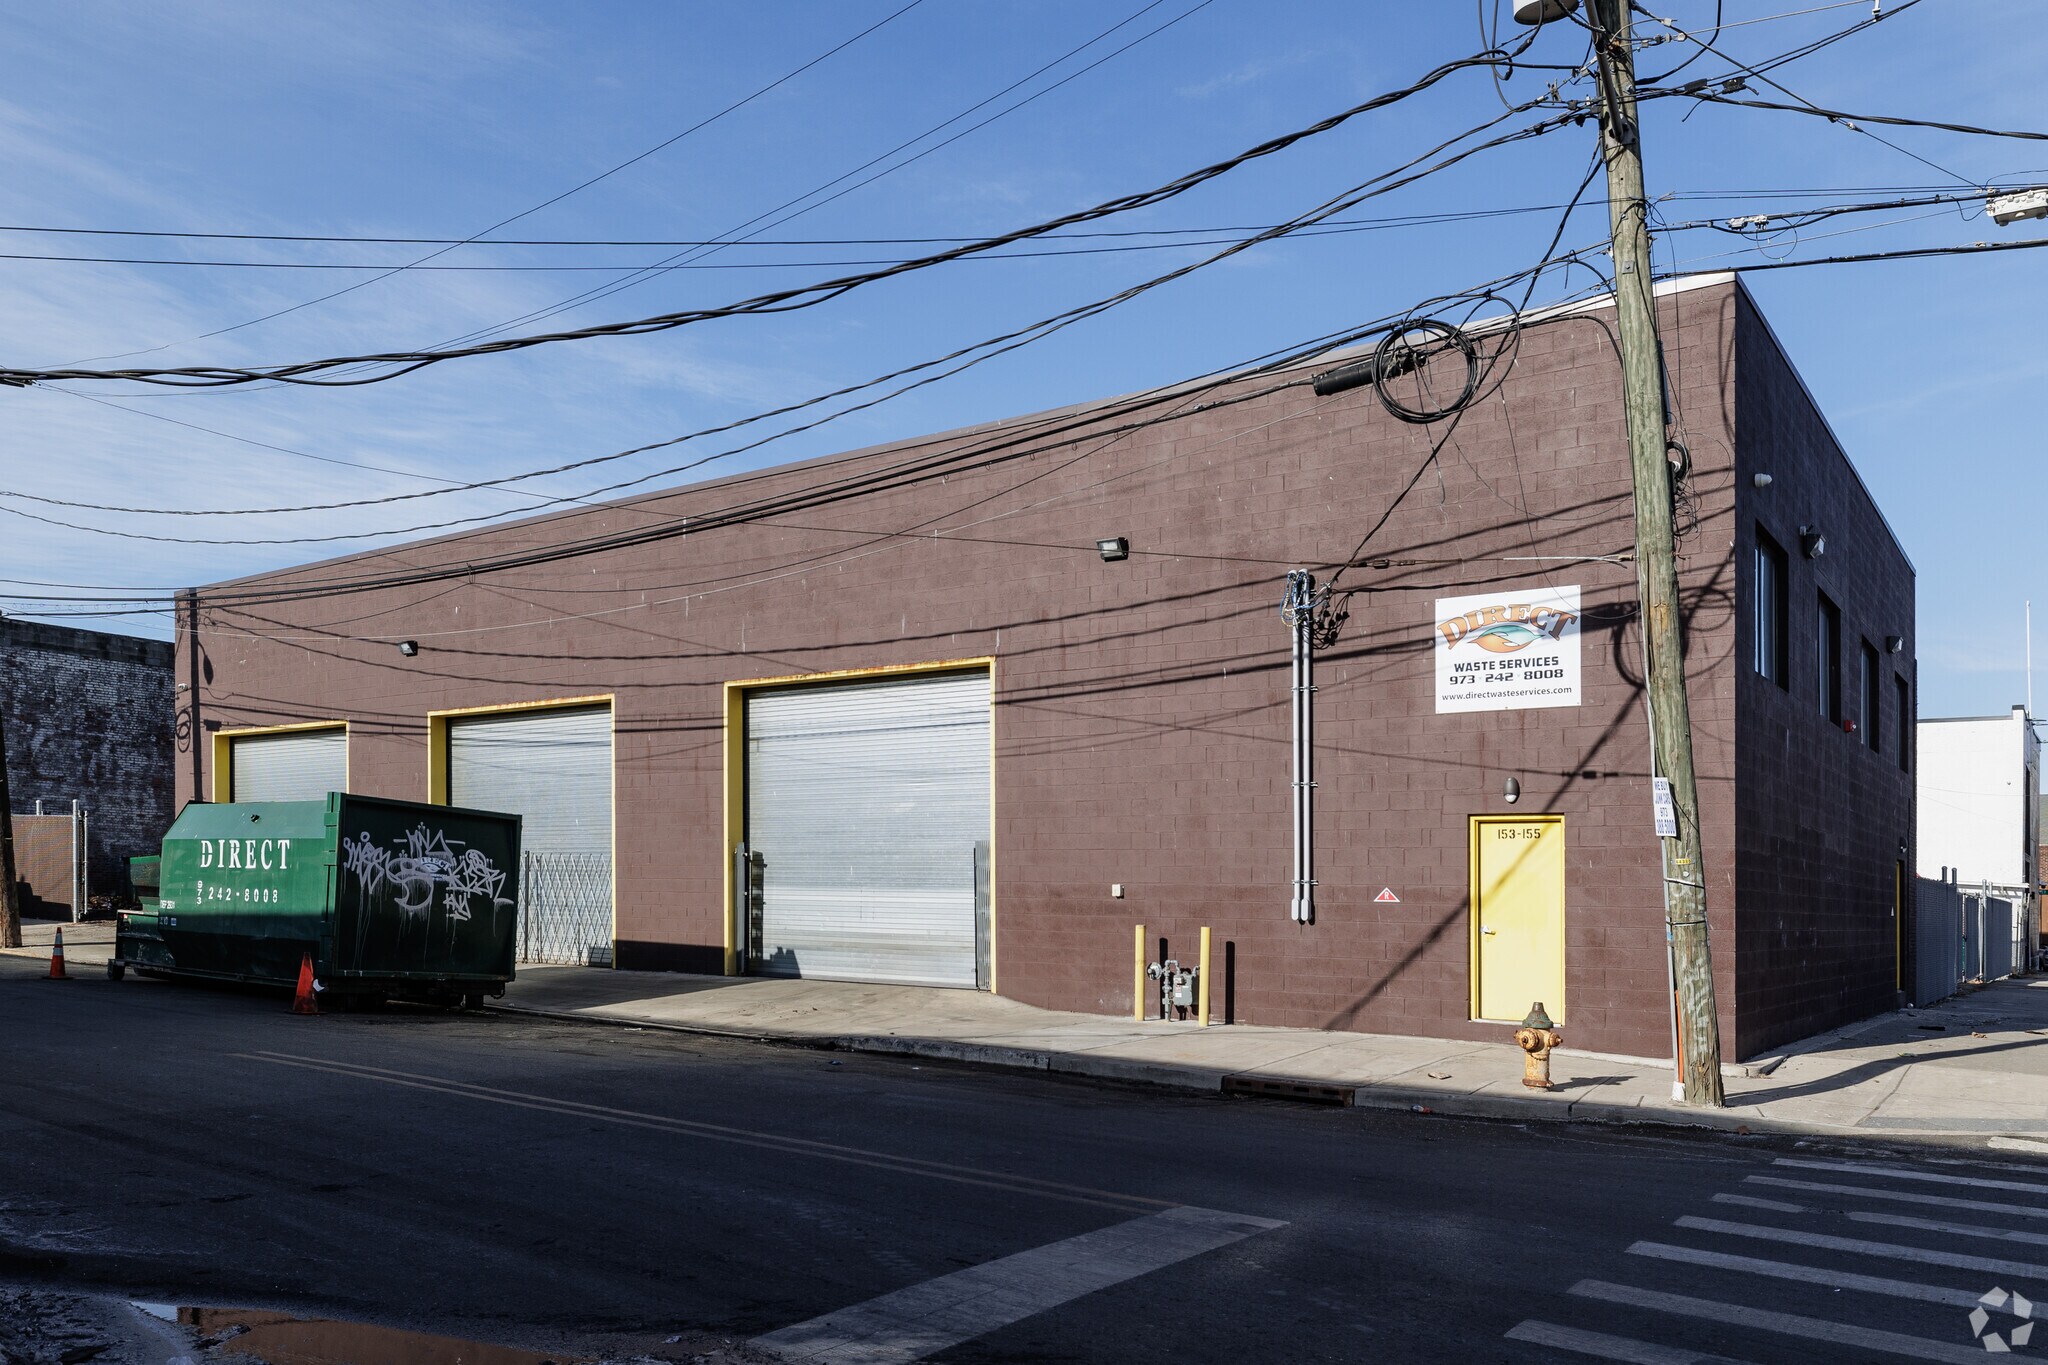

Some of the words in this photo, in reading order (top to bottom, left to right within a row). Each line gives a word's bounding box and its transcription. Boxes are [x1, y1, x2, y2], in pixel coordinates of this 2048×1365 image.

[1437, 603, 1578, 650] DIRECT
[1454, 661, 1495, 672] WASTE
[1500, 656, 1559, 669] SERVICES
[1450, 675, 1475, 685] 973
[1485, 672, 1514, 683] 242
[1524, 669, 1564, 680] 8008
[1442, 686, 1572, 701] www.directwasteservices.com
[1498, 828, 1541, 840] 153-155
[200, 839, 290, 870] DIRECT
[413, 856, 453, 873] IRECT
[1384, 891, 1390, 900] R
